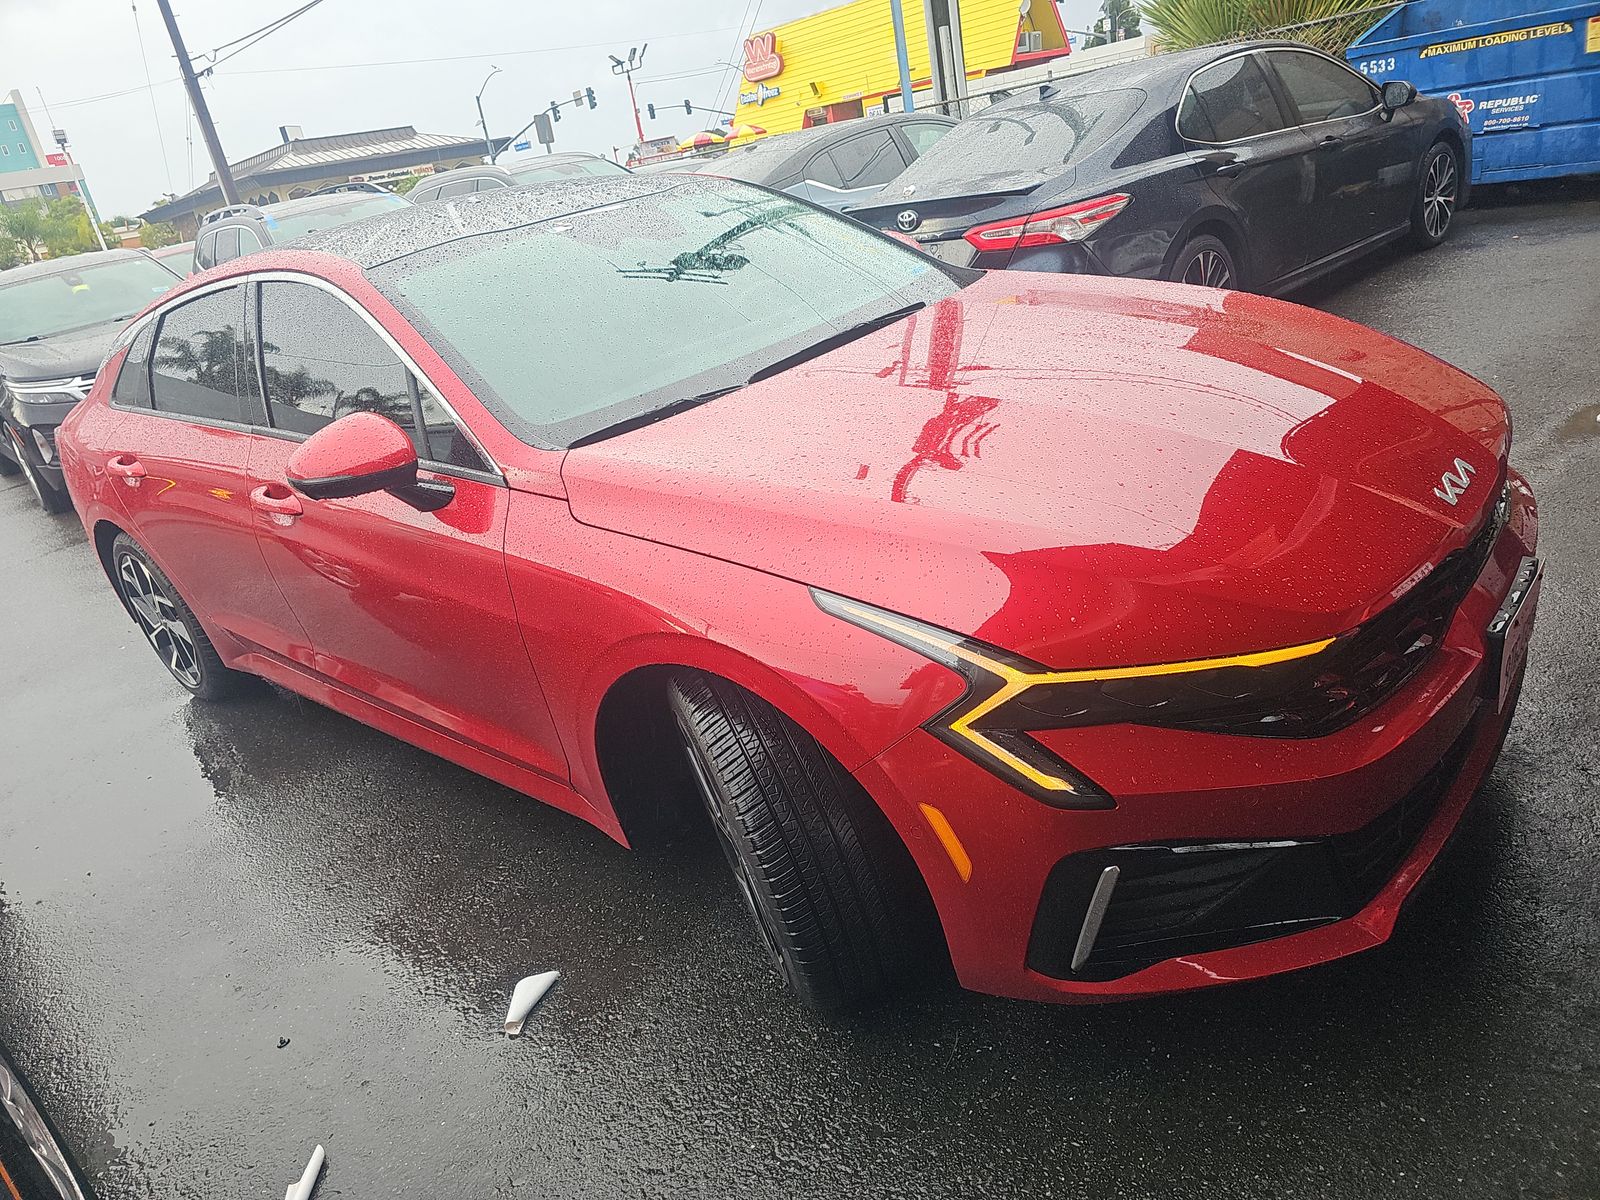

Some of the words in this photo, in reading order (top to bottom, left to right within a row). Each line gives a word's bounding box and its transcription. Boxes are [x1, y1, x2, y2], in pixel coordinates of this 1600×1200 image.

[744, 32, 774, 64] W
[1427, 40, 1477, 57] MAXIMUM
[1479, 31, 1528, 48] LOADING
[1530, 25, 1566, 39] LEVEL
[1359, 57, 1396, 75] 5533
[1479, 94, 1538, 110] REPUBLIC
[1491, 104, 1525, 115] SERVICES
